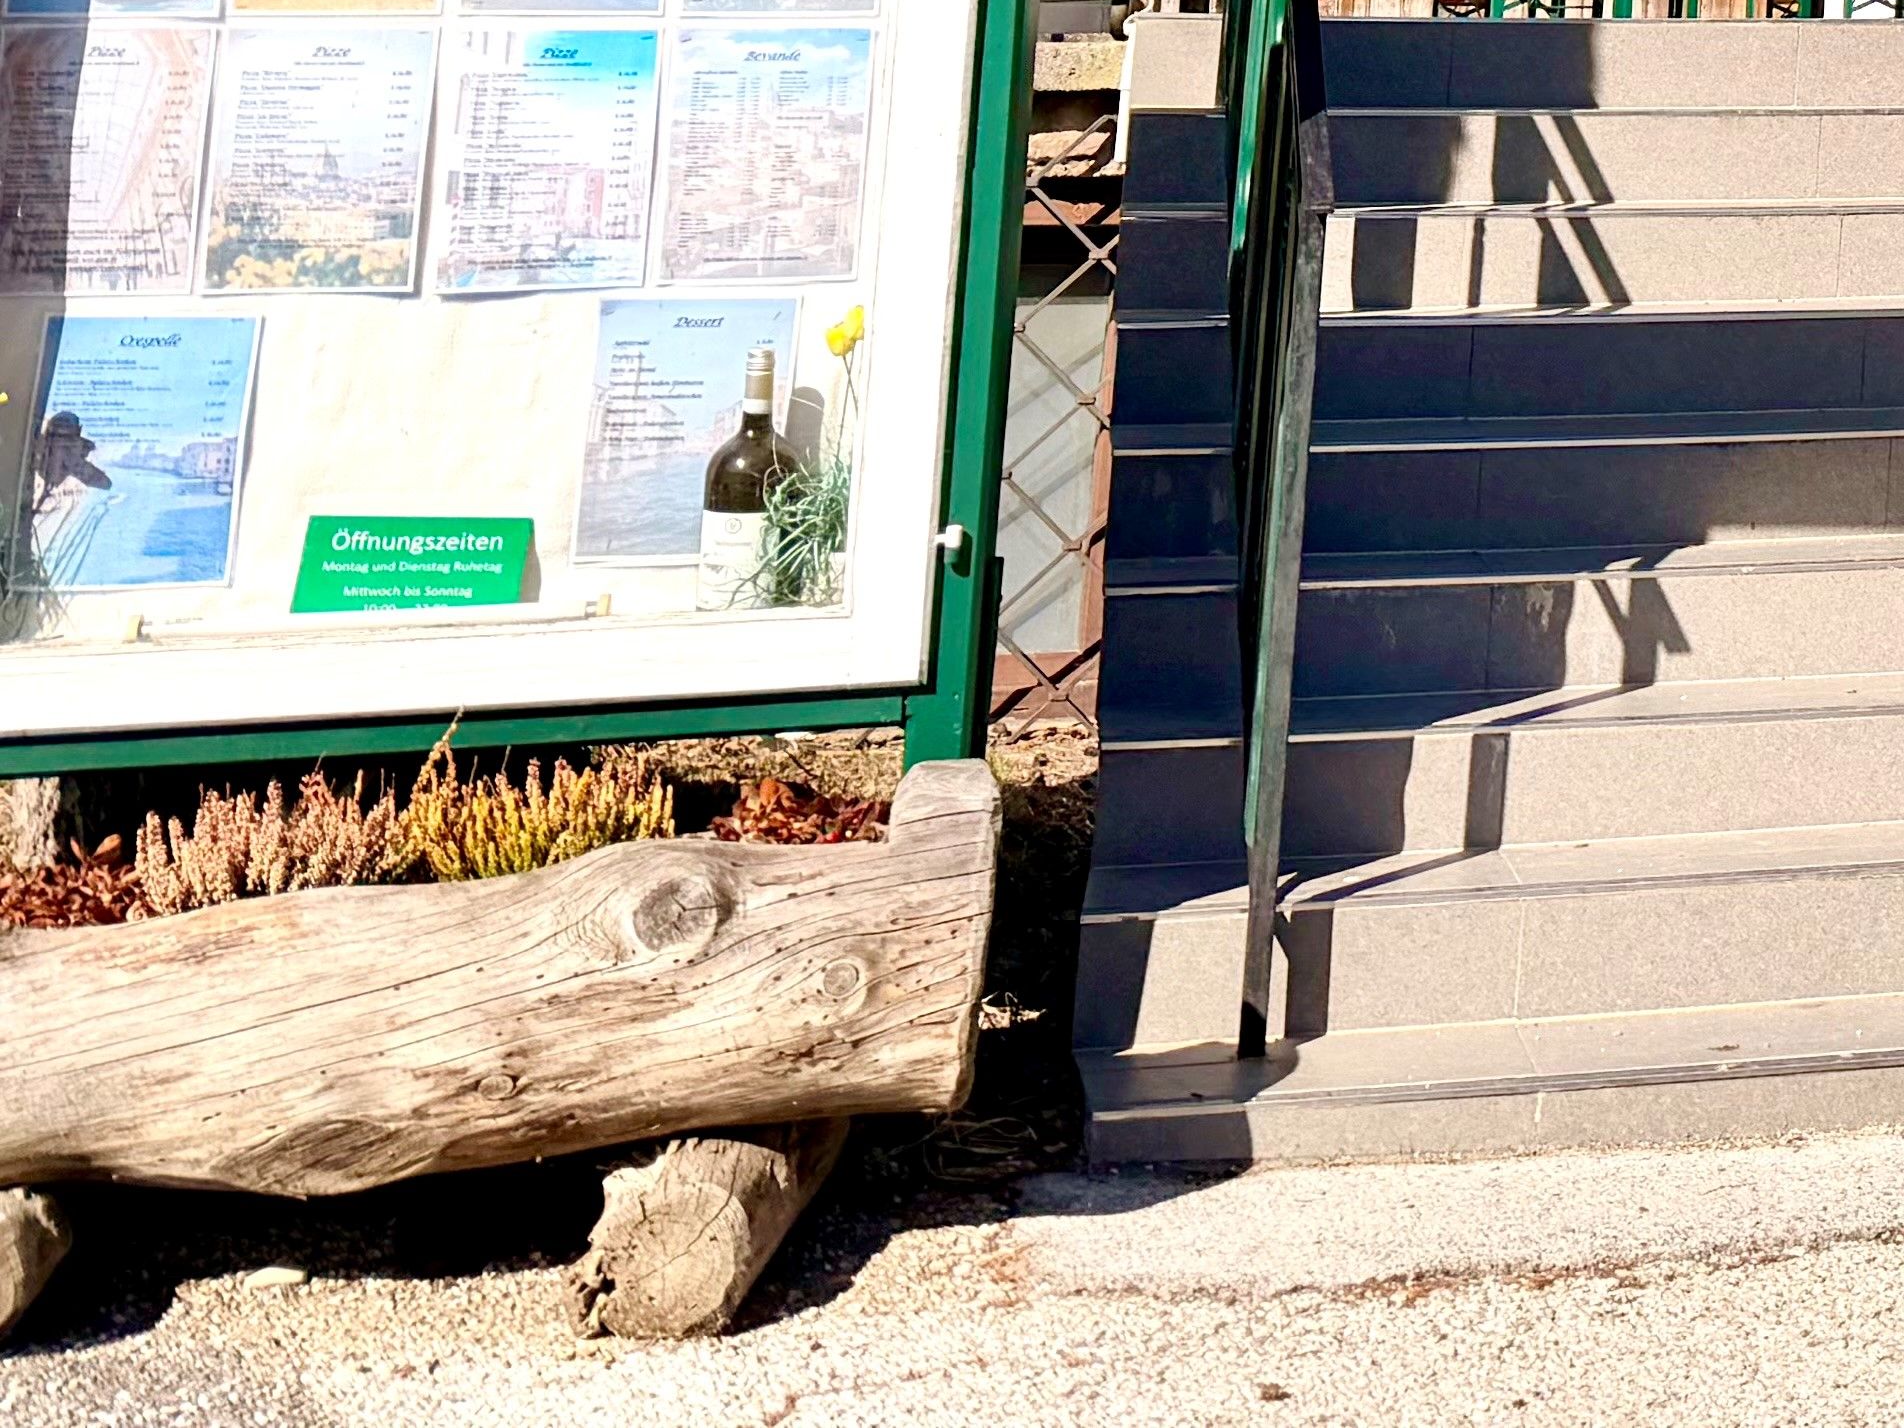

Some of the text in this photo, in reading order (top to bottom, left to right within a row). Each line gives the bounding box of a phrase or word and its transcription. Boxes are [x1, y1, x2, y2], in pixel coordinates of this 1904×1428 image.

[672, 316, 725, 329] Dessert
[331, 528, 503, 556] Öffnungszeiten
[322, 560, 503, 575] Montag und Dienstag Ruhetag
[343, 586, 473, 599] Mittwoch bis Sonntag
